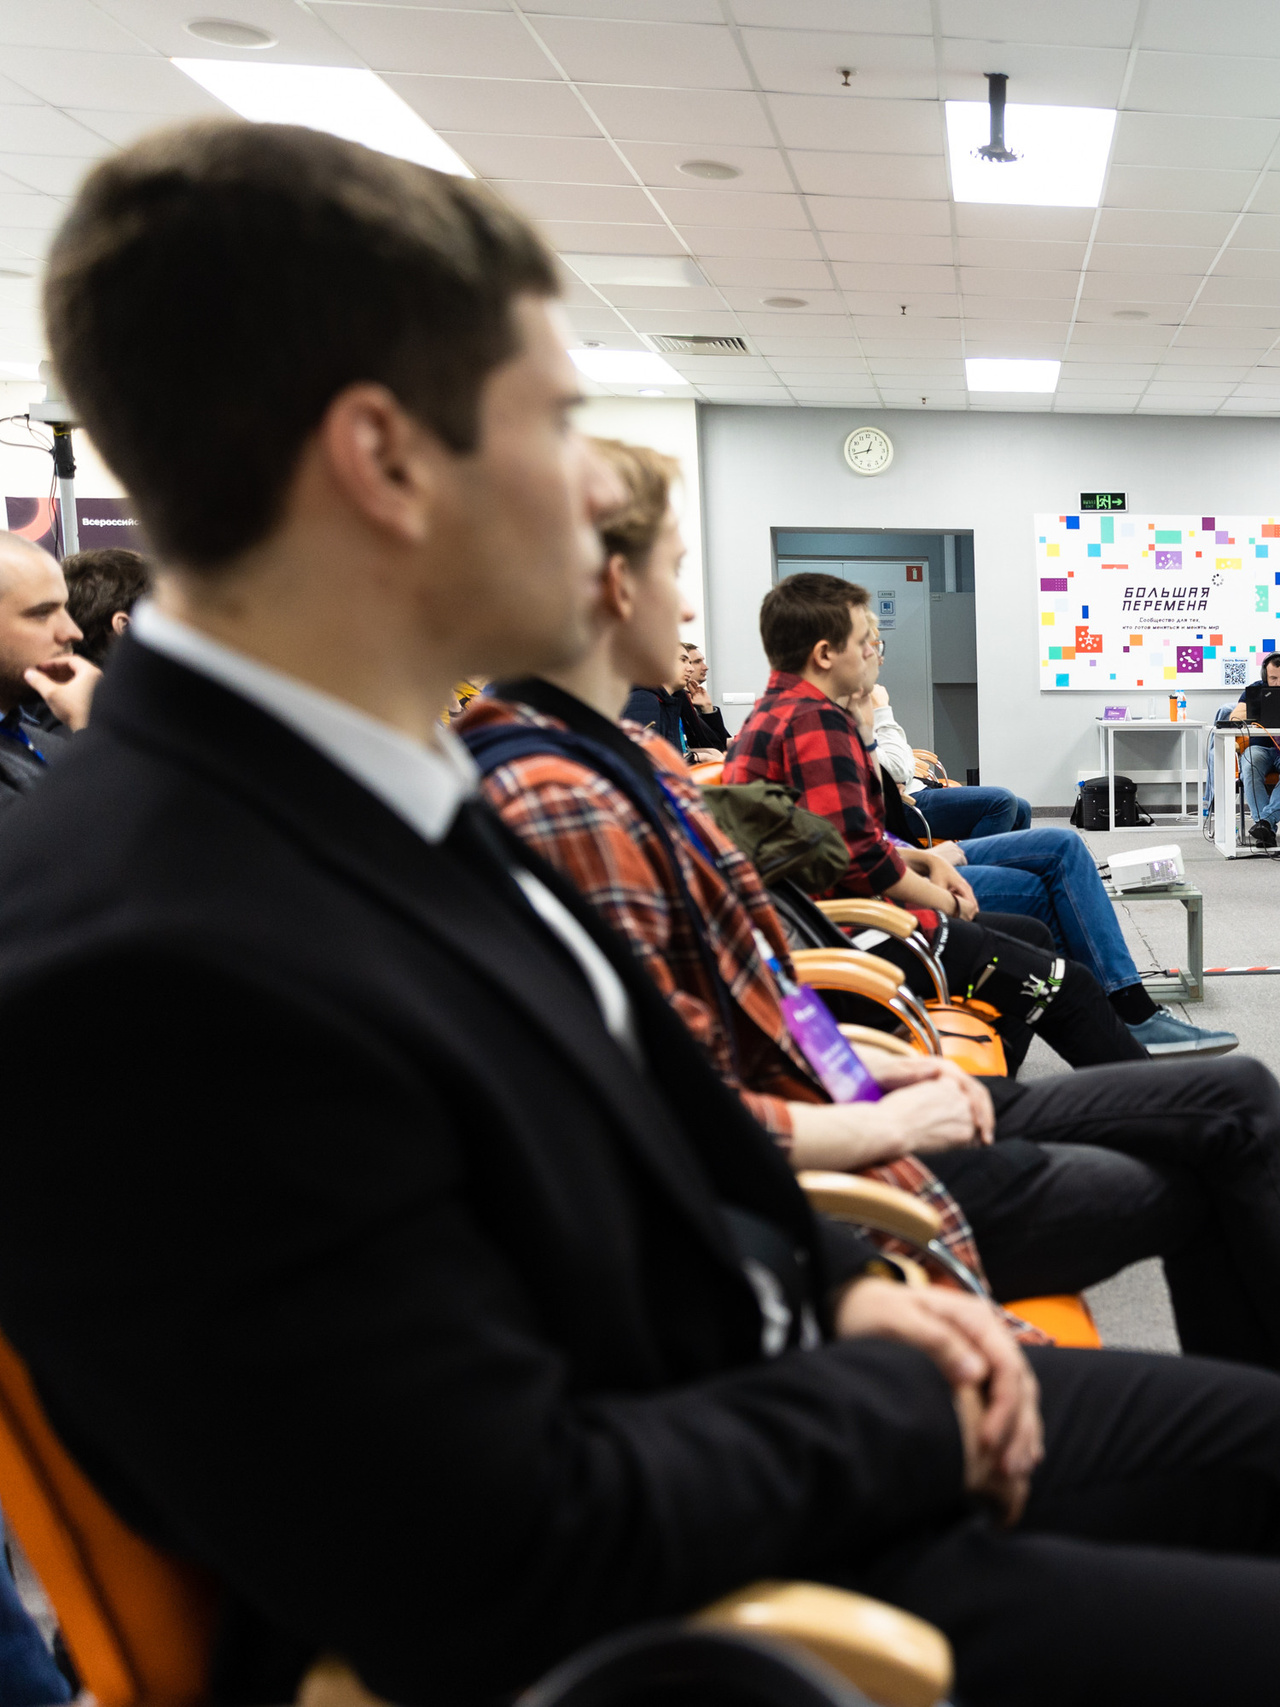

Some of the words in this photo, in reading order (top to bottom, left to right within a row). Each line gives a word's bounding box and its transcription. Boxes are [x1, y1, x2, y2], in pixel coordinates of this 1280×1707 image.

[82, 517, 141, 527] Всероссийс
[1124, 587, 1210, 598] БОЛЬШАЯ
[1122, 600, 1208, 611] ПЕРЕМЕНА
